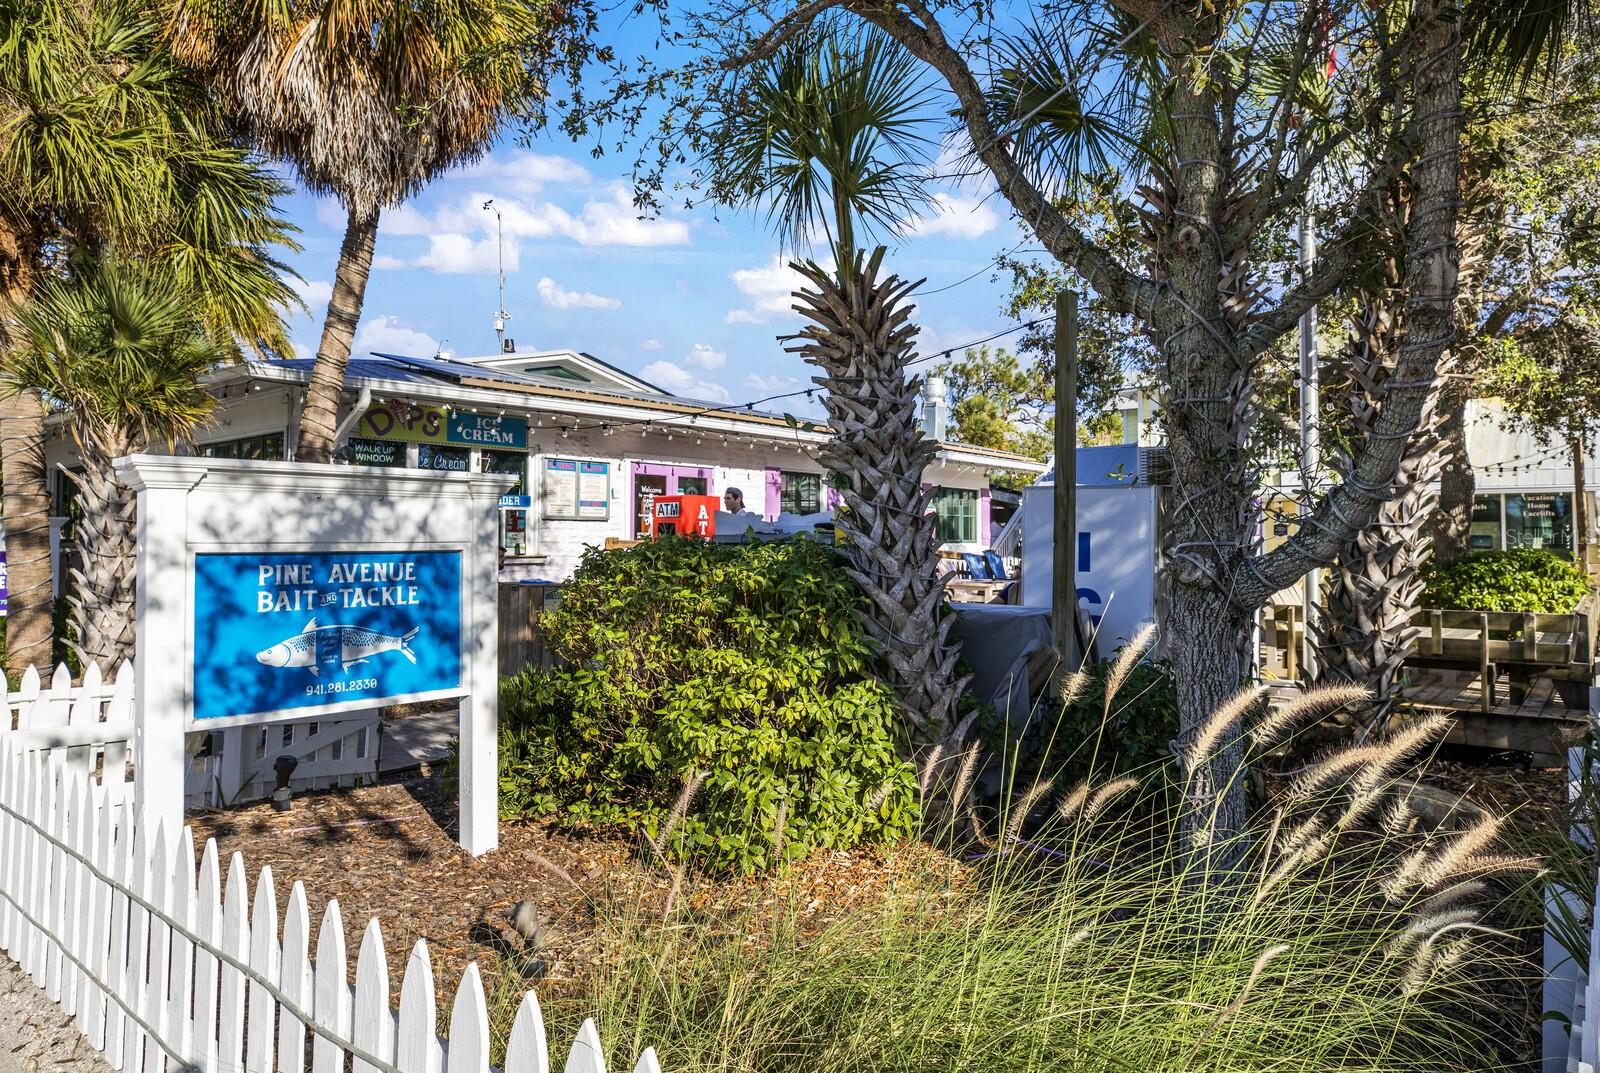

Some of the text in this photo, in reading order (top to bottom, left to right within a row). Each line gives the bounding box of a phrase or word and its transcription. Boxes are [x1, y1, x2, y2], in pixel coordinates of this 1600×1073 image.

[462, 428, 514, 444] CREAM
[355, 444, 395, 454] WALK UP
[355, 453, 394, 463] WINDOW
[433, 455, 466, 471] Cream
[657, 503, 678, 516] ATM
[697, 504, 710, 543] AT
[258, 561, 417, 586] PINE AVENUE
[257, 585, 420, 613] BAIT AND TACKLE
[305, 677, 378, 696] 941.281.2330
